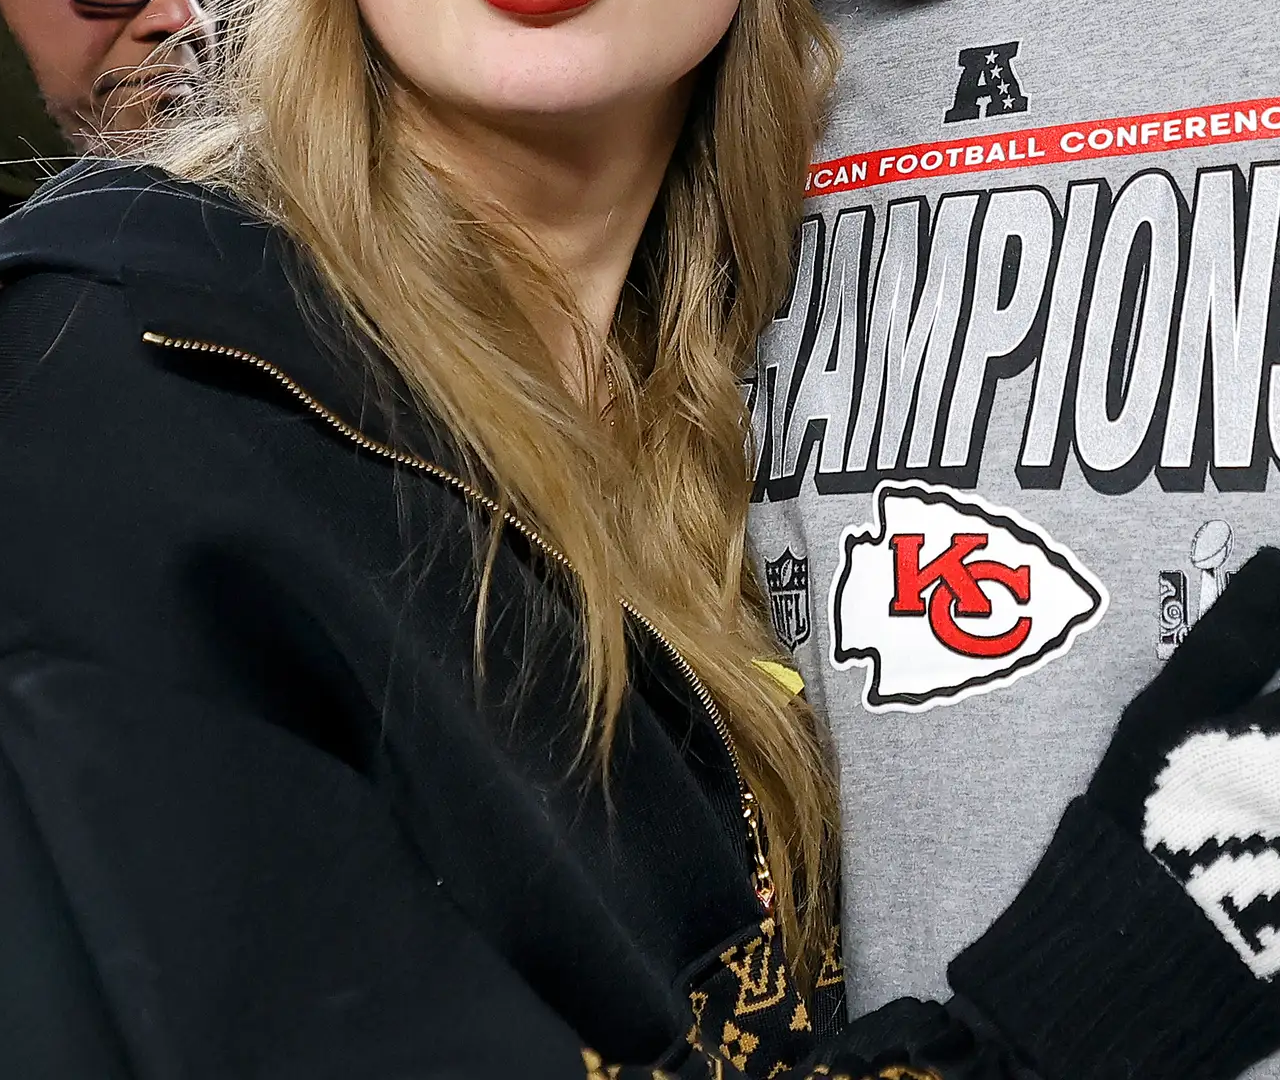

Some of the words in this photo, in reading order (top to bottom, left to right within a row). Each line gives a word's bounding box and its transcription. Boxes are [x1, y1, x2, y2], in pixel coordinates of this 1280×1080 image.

[878, 137, 1045, 177] FOOTBALL
[771, 592, 809, 642] NFL
[889, 533, 1033, 658] KC
